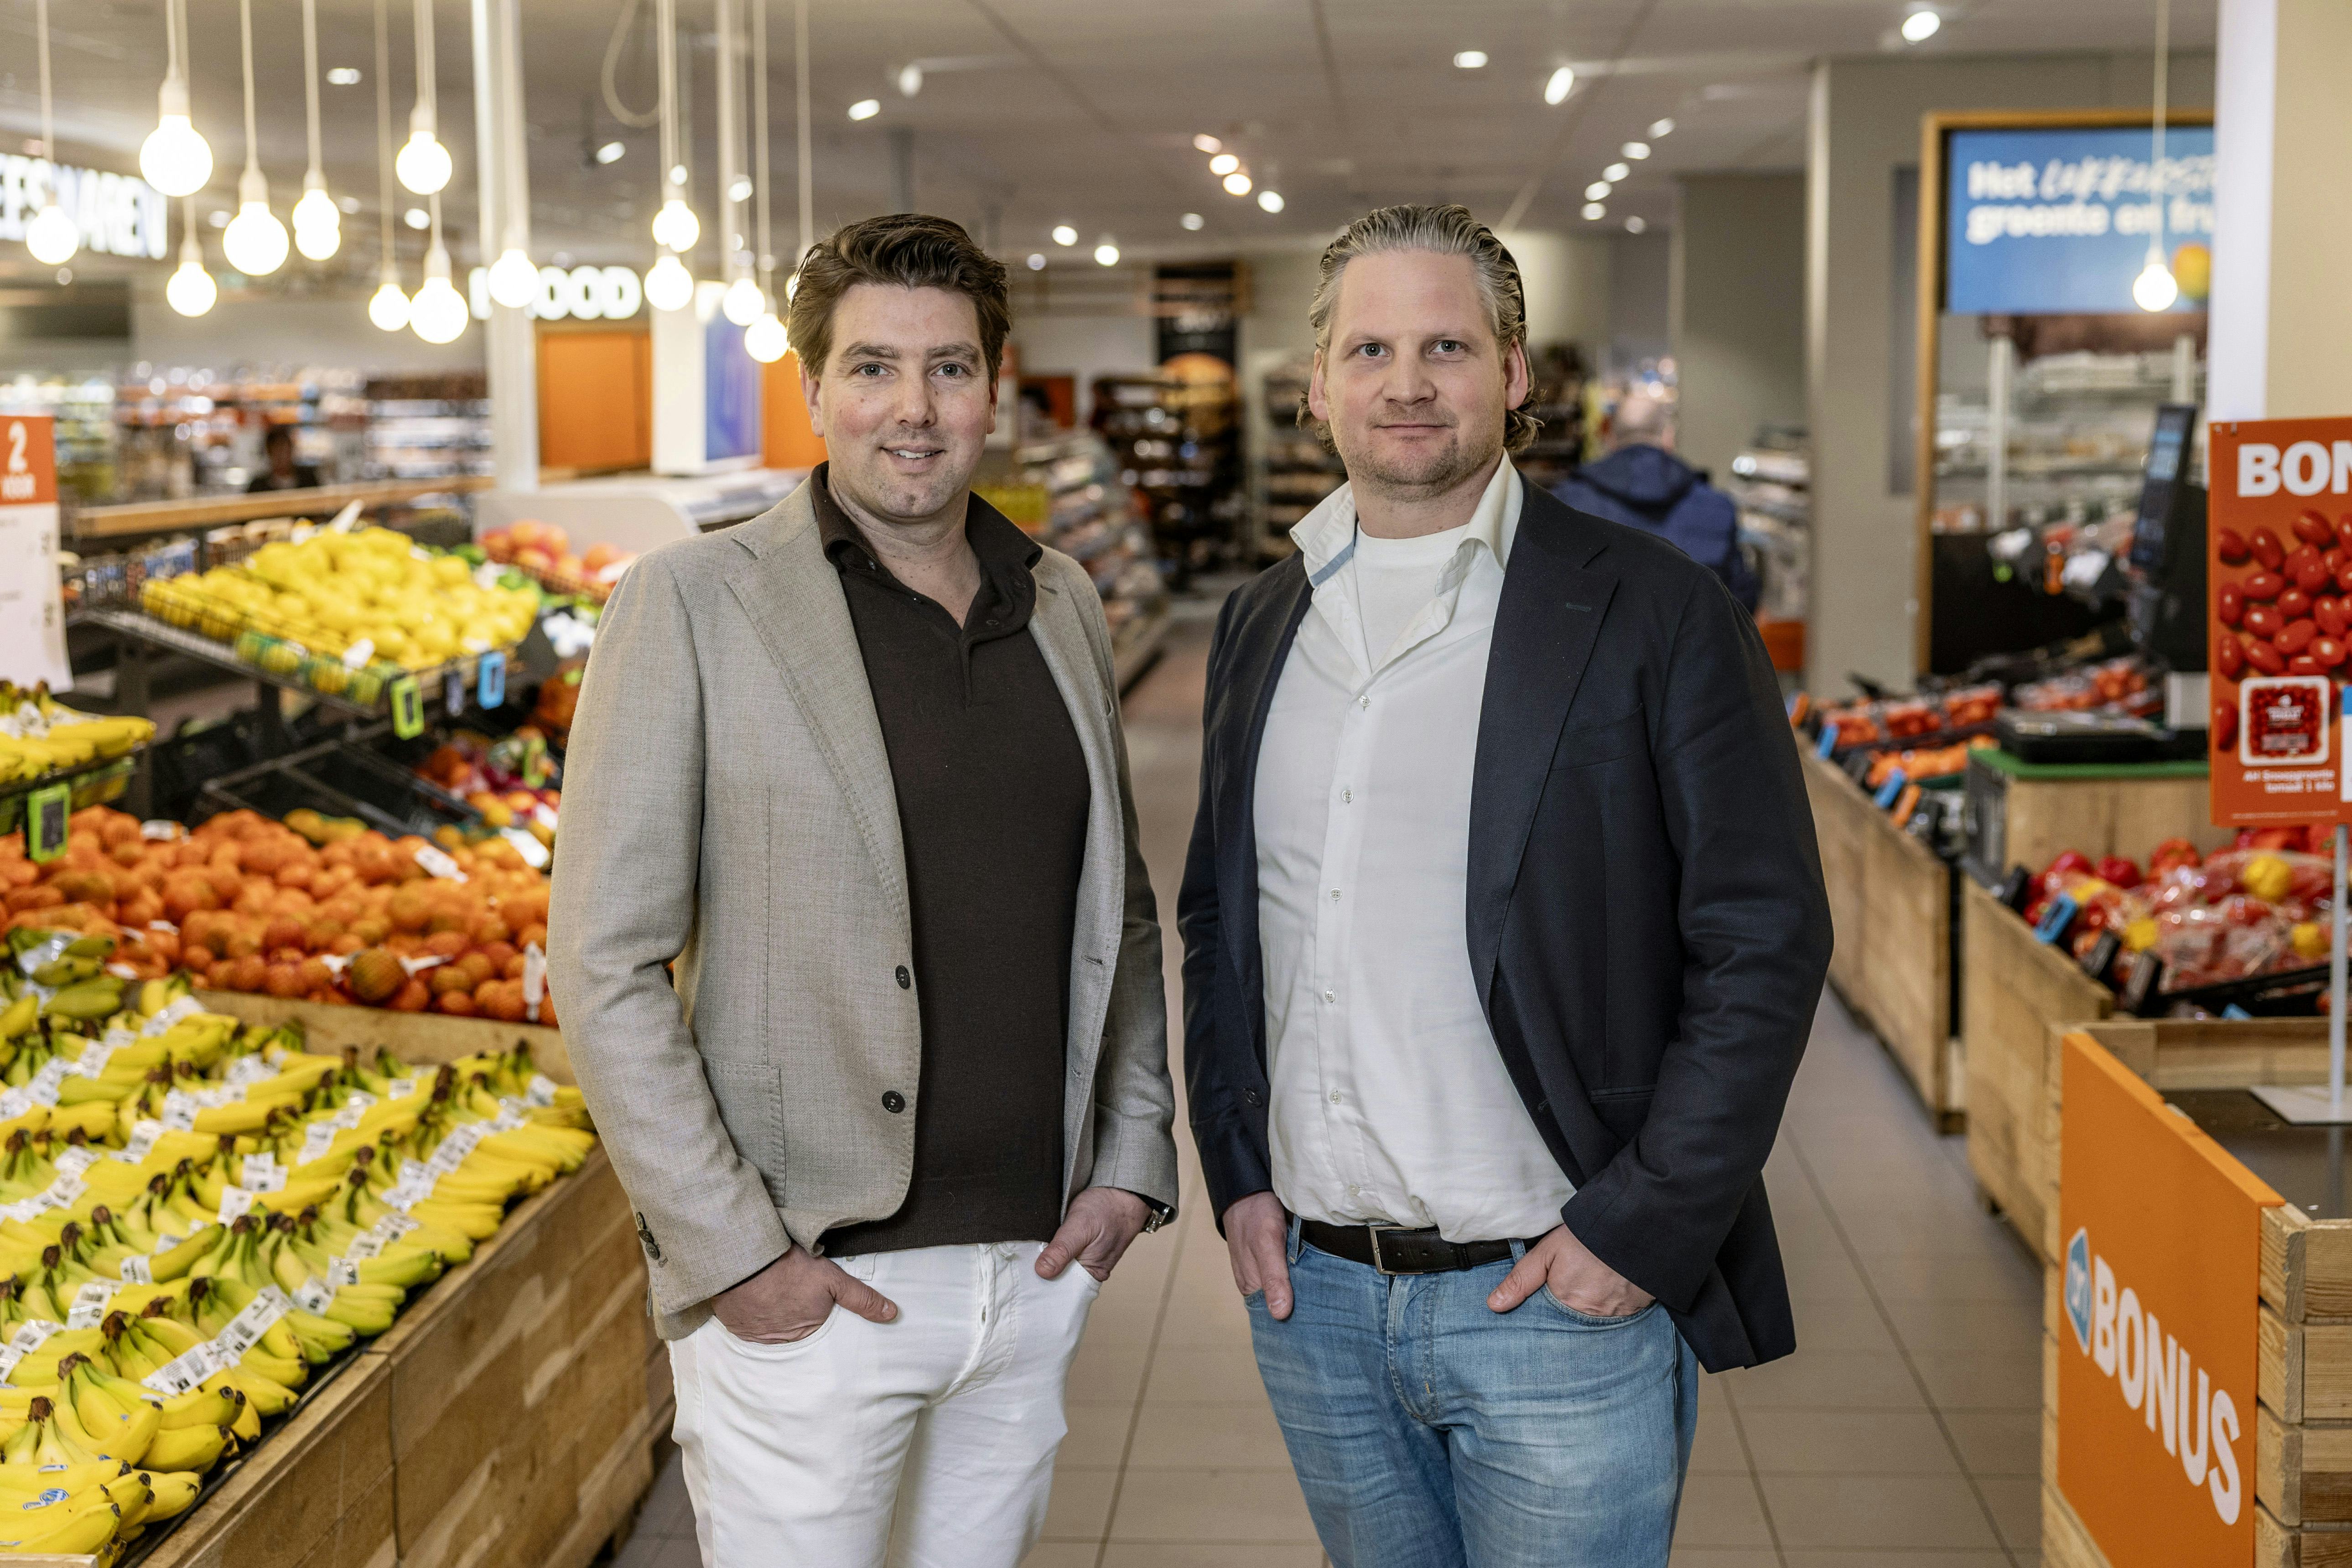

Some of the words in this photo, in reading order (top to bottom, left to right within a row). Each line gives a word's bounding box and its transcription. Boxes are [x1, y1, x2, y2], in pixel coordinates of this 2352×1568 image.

[0, 152, 167, 260] ESWAREN
[1967, 160, 2037, 200] Het
[1966, 202, 2110, 245] groente
[2114, 202, 2162, 235] en
[468, 266, 642, 320] OOD
[8, 421, 28, 473] 2
[2094, 1255, 2241, 1526] BONUS
